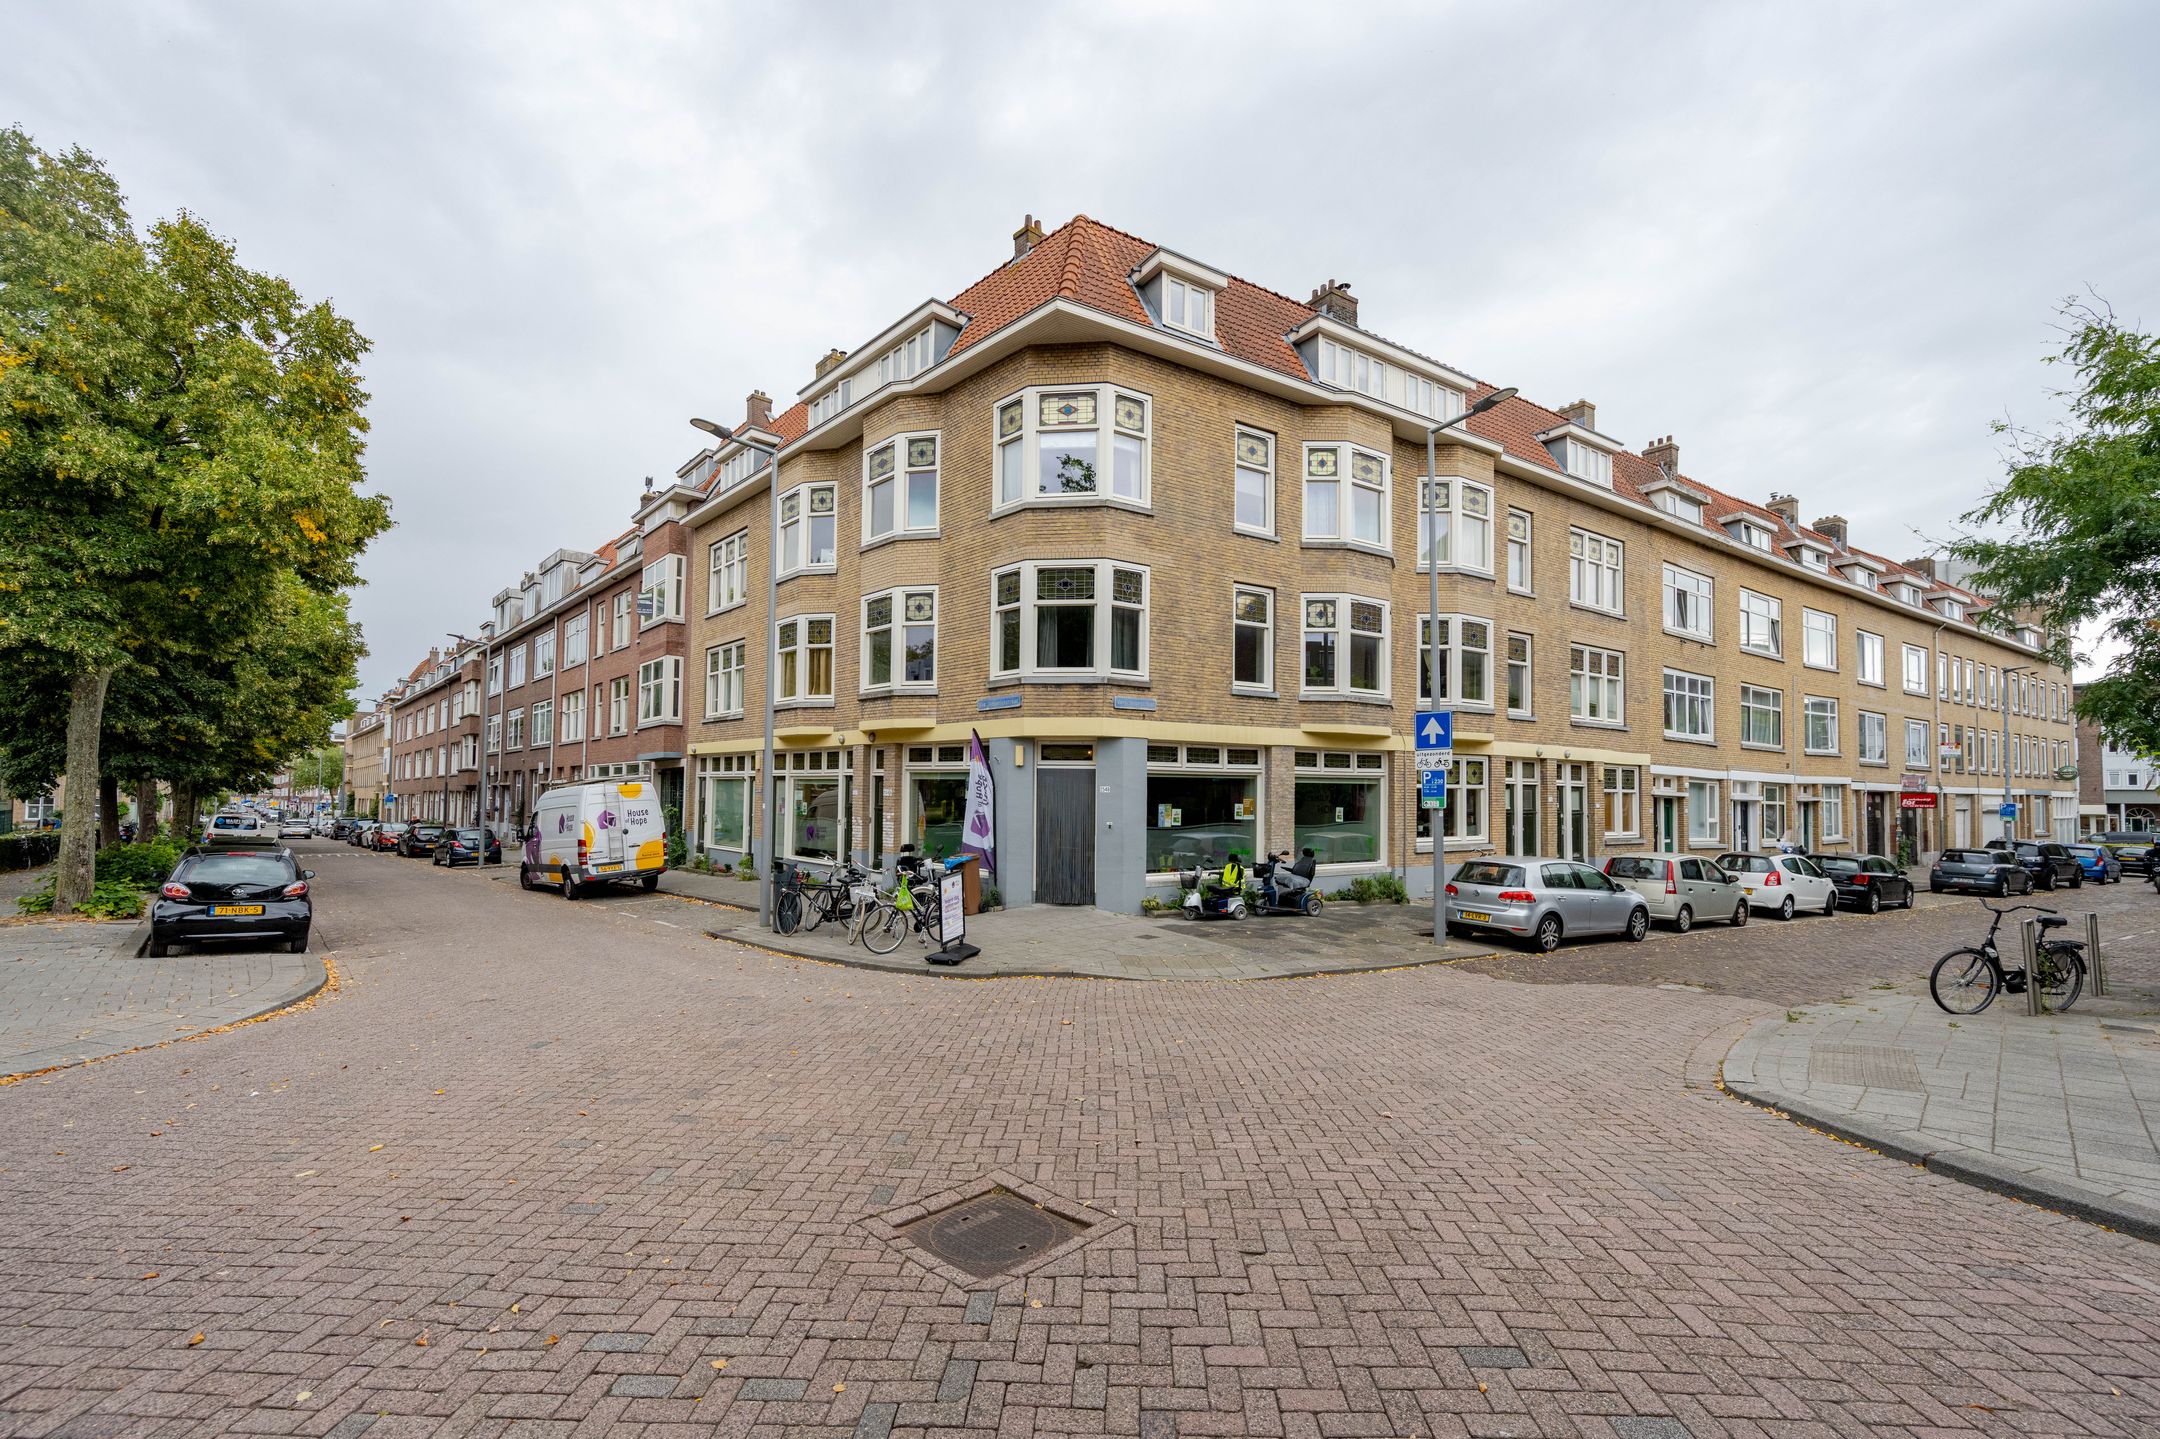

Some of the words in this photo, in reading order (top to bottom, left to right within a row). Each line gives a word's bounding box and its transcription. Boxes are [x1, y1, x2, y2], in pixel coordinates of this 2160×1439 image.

[1423, 771, 1432, 784] P
[627, 808, 649, 817] House
[630, 817, 648, 826] Hope
[219, 906, 259, 914] 71-NBK-5
